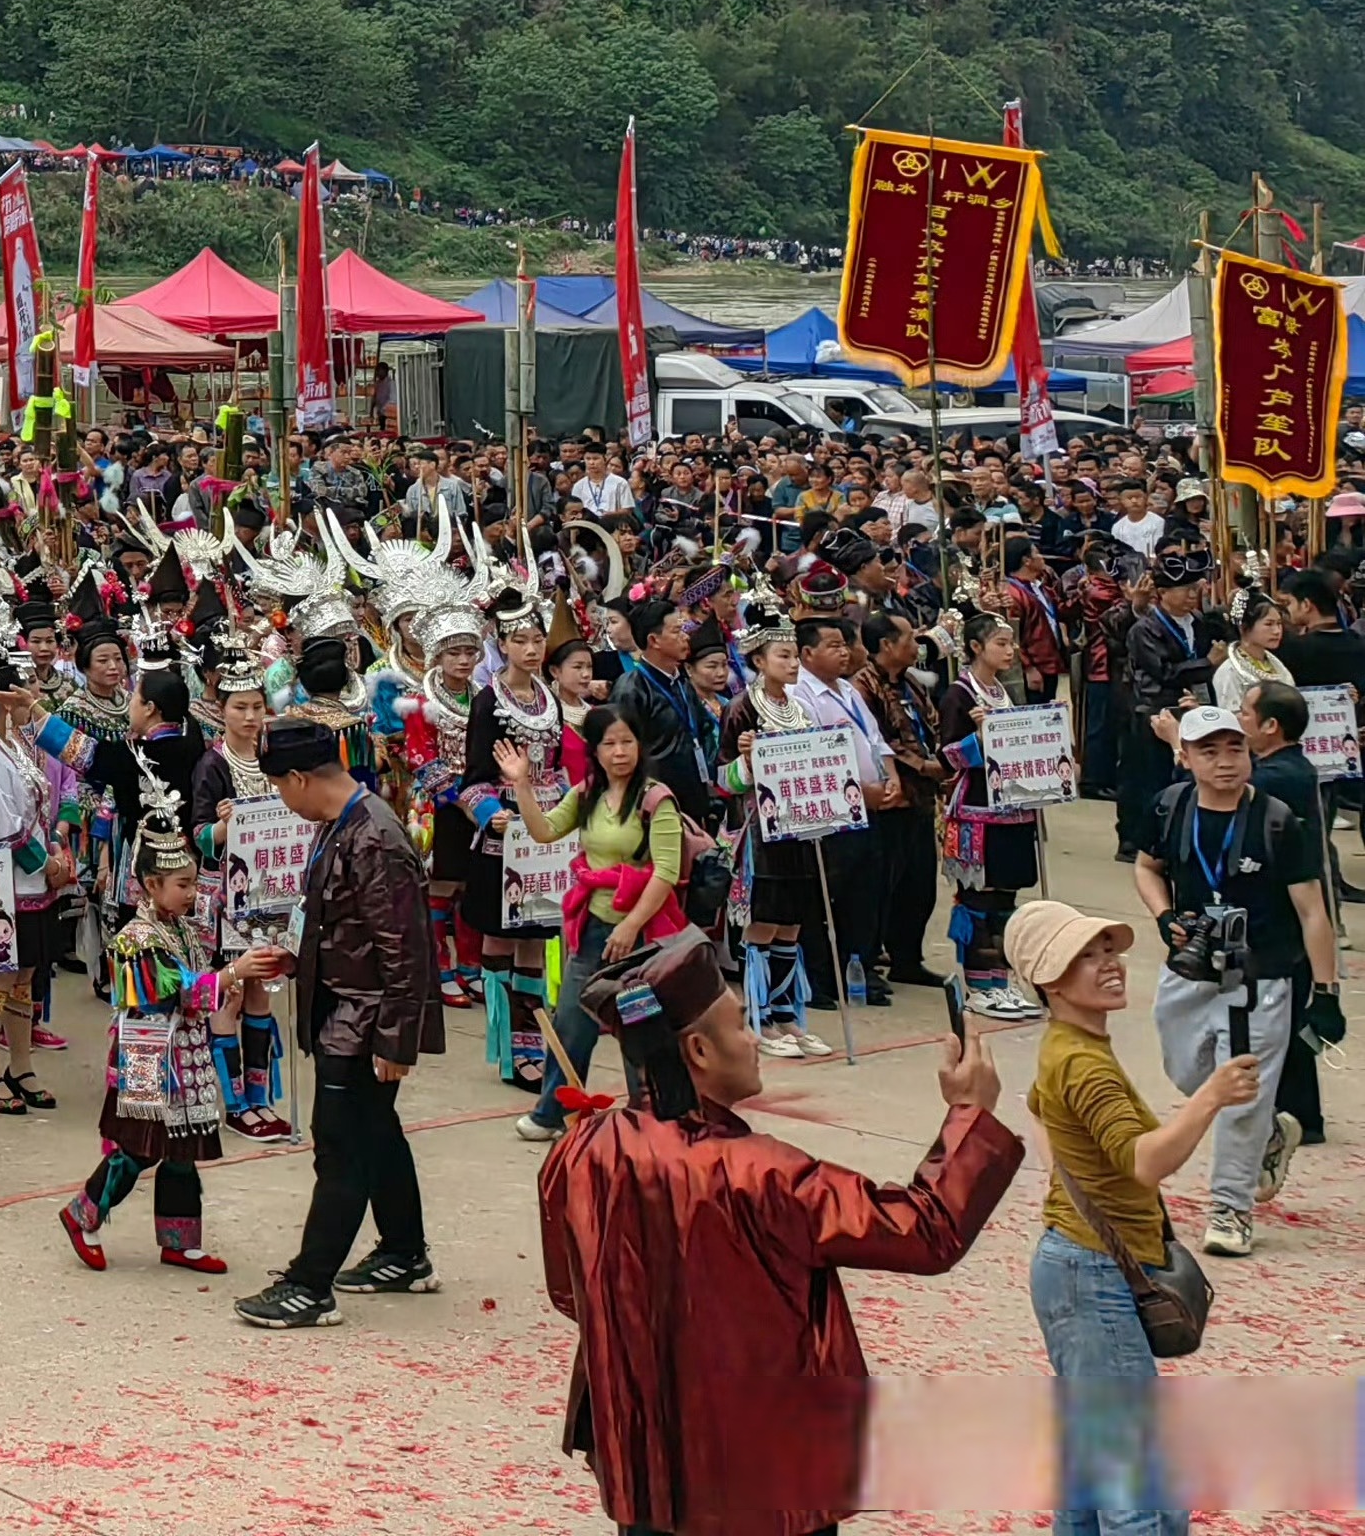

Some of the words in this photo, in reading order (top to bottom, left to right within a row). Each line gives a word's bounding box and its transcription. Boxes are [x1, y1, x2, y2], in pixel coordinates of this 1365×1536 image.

[778, 772, 838, 798] 苗族盛装
[791, 798, 836, 823] 方块队
[254, 844, 311, 869] 侗族盛
